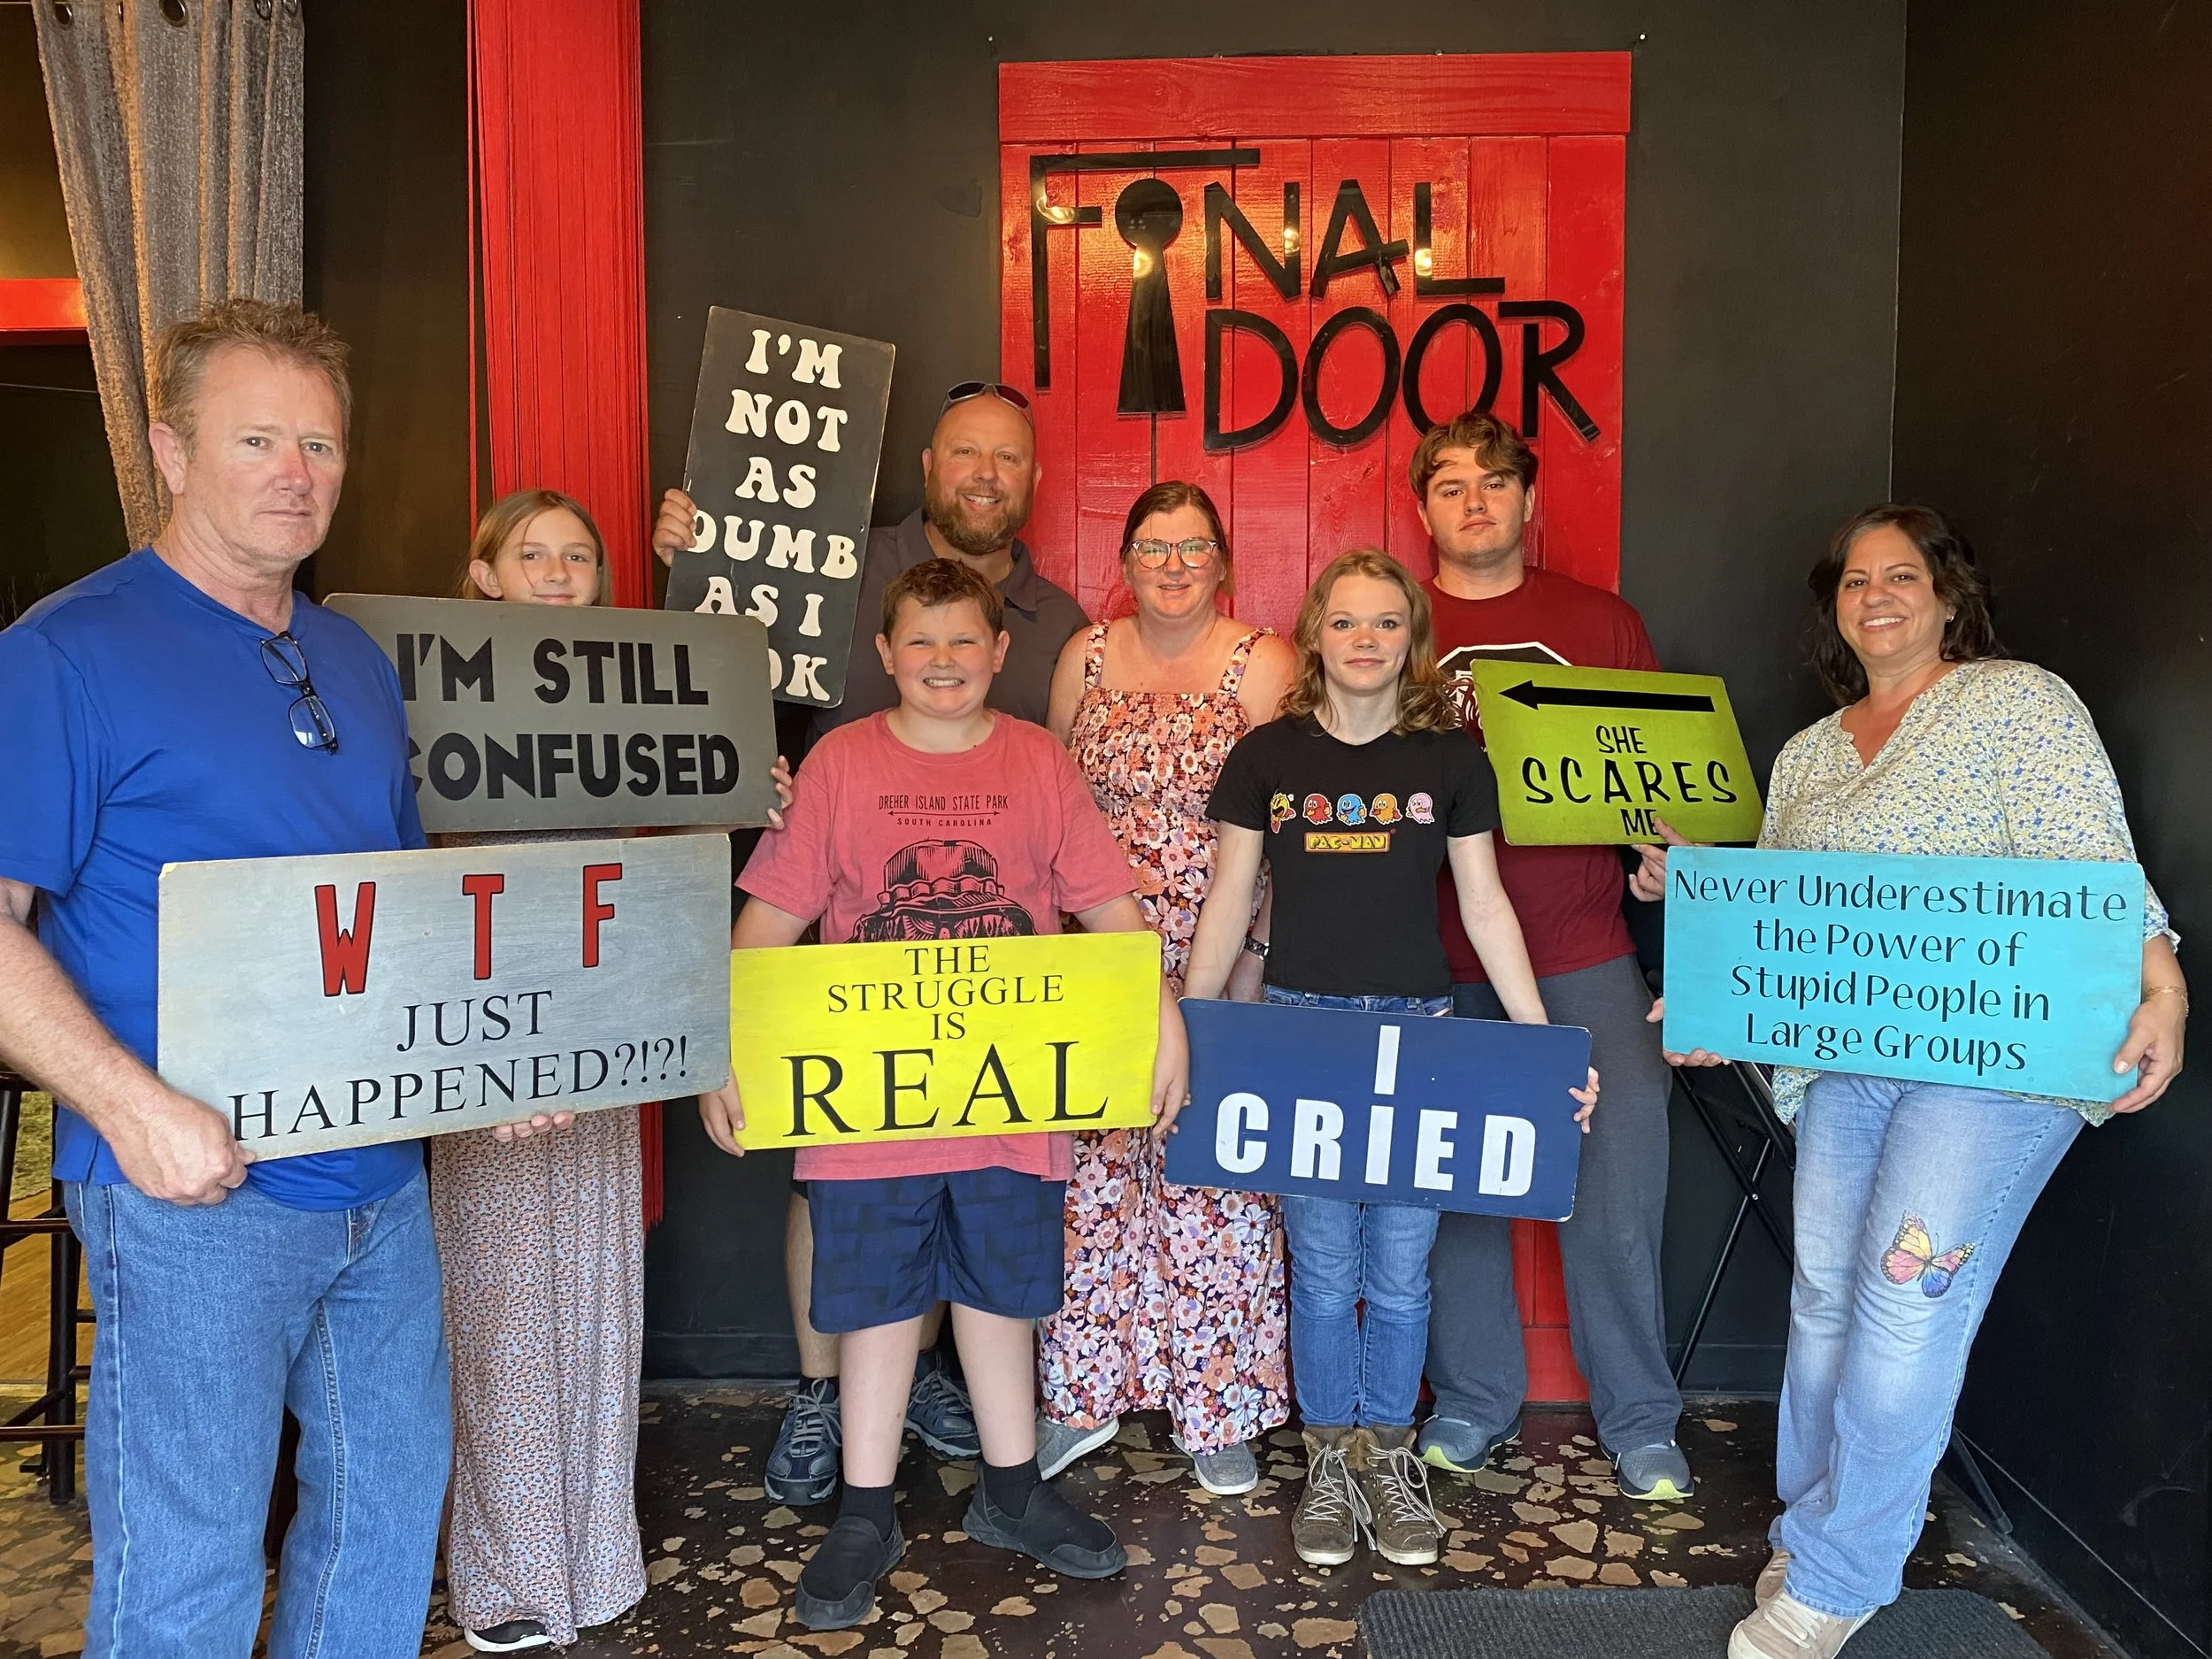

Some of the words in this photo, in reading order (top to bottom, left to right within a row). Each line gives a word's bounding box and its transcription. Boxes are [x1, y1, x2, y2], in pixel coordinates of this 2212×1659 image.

[744, 328, 843, 389] I'M
[1203, 299, 1600, 450] DOOR
[725, 388, 849, 452] NOT
[734, 456, 817, 509] AS
[687, 509, 858, 579] DUMB
[695, 576, 779, 627] AS
[798, 593, 825, 637] I
[396, 634, 495, 702] I'M
[533, 638, 709, 705] STILL
[1596, 725, 1647, 754] SHE
[879, 795, 909, 810] DREHER
[916, 795, 946, 810] ISLAND
[953, 795, 980, 810] STATE
[986, 795, 1009, 810] PARK
[1522, 756, 1737, 804] SCARES
[897, 818, 932, 826] SOUTH
[939, 818, 993, 827] CAROLINA
[1309, 834, 1386, 850] PAC-MAN
[1621, 808, 1662, 836] ME
[1674, 869, 1788, 904] Never
[1798, 874, 2127, 921] Underestimate
[904, 945, 992, 976] THE
[1753, 918, 1816, 954] the
[1827, 923, 1966, 963] Power
[1978, 931, 2028, 967] of
[396, 990, 553, 1052] JUST
[827, 974, 1064, 1013] STRUGGLE
[1731, 964, 1856, 1010] Stupid
[1867, 974, 2001, 1022] People
[2013, 984, 2049, 1020] in
[930, 1012, 966, 1041] IS
[1747, 1012, 1863, 1061] Large
[1874, 1025, 2026, 1076] Groups
[227, 1035, 688, 1141] HAPPENED?!?!
[780, 1041, 1109, 1137] REAL
[1374, 1025, 1401, 1095] I
[1215, 1092, 1536, 1197] CRIED
